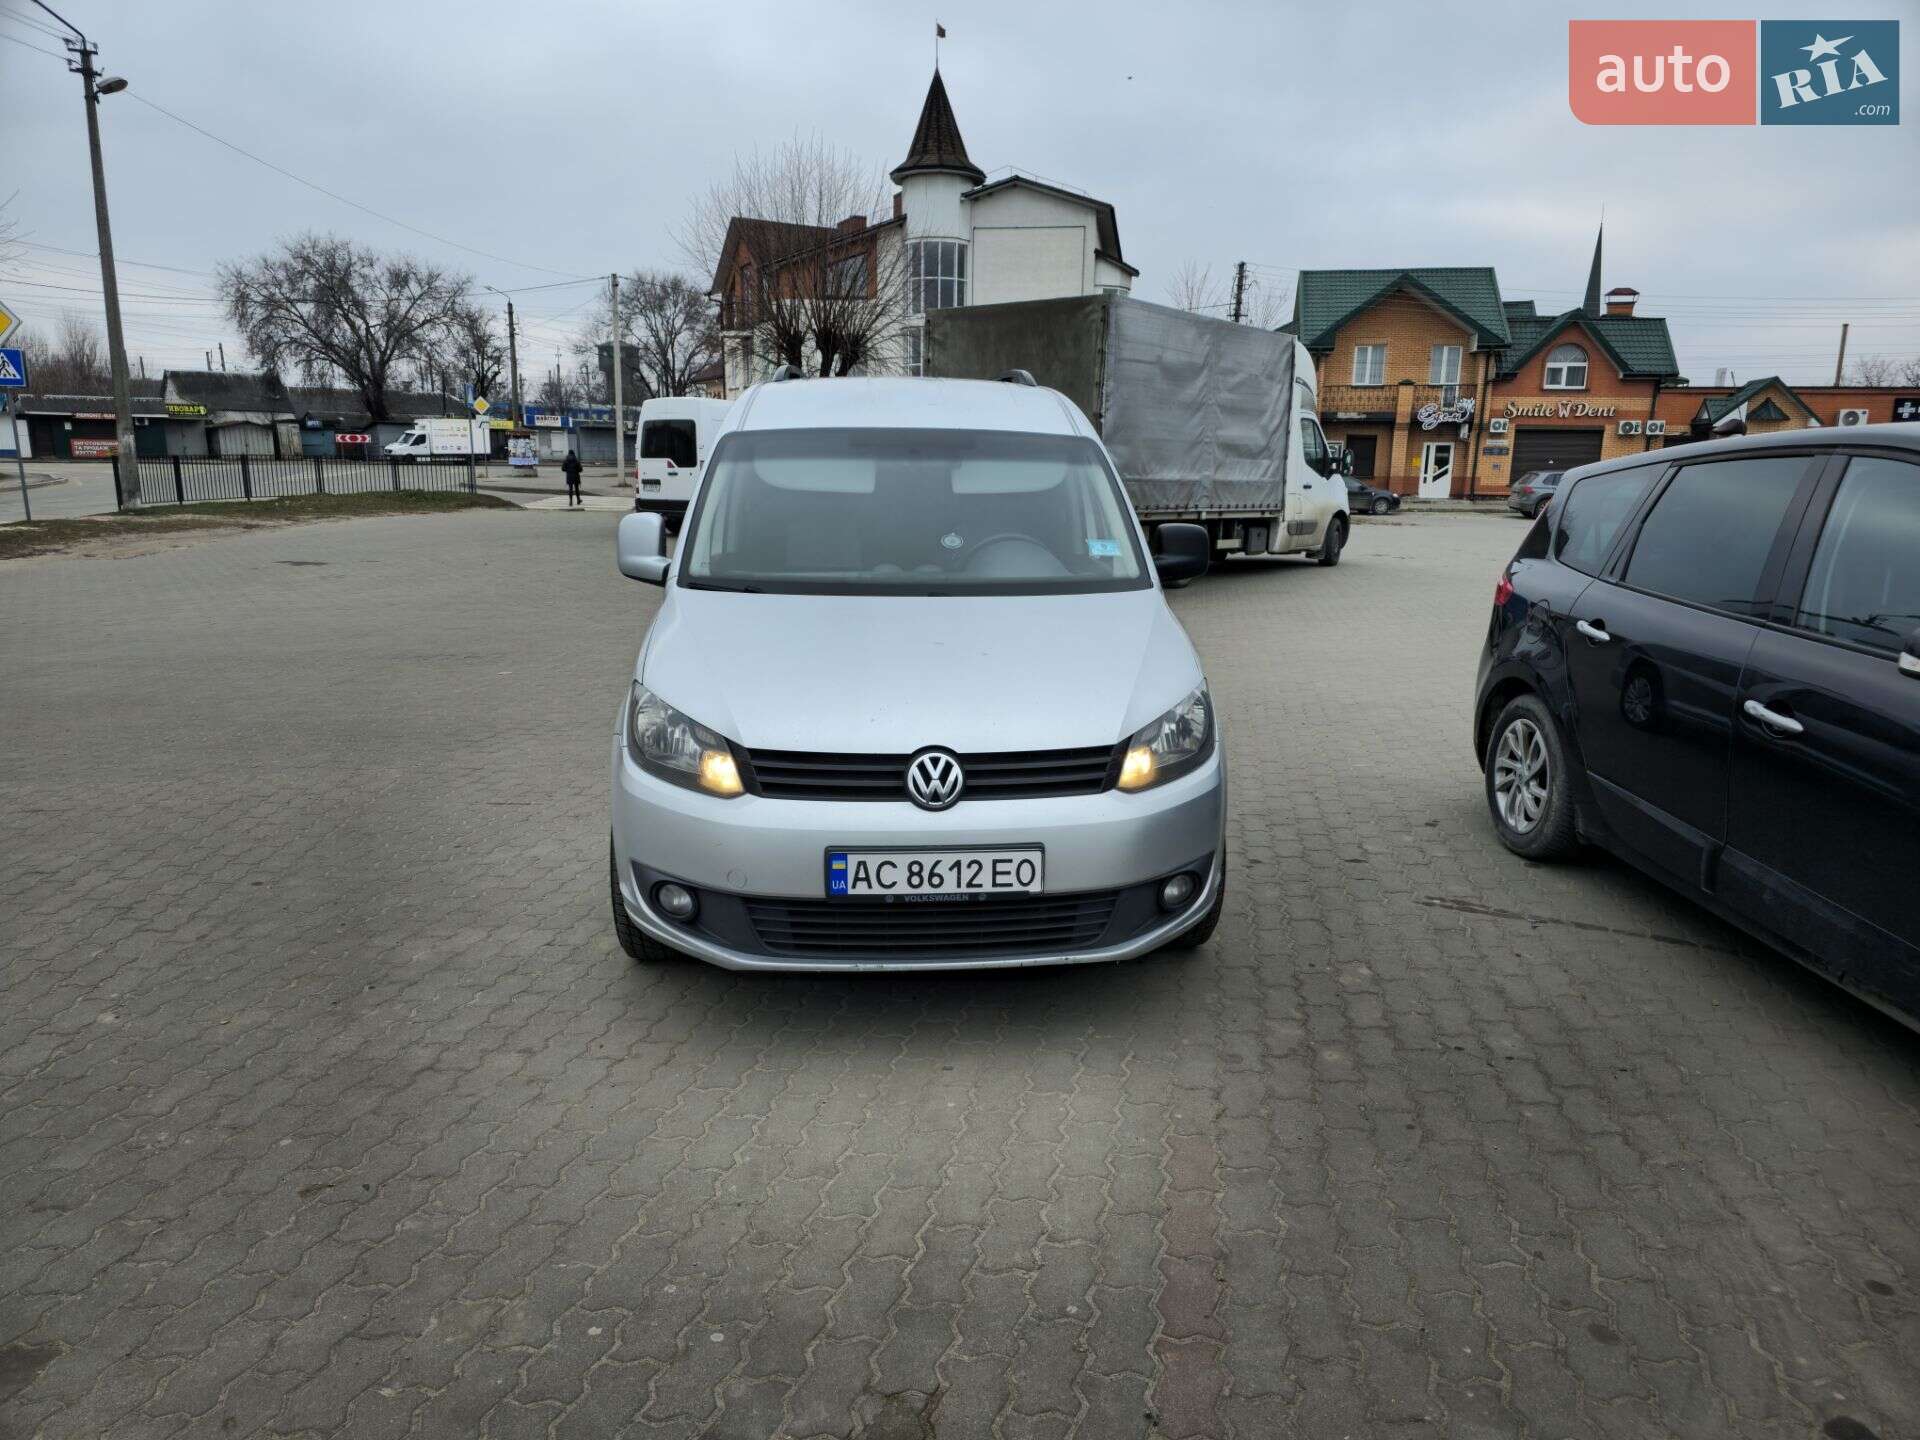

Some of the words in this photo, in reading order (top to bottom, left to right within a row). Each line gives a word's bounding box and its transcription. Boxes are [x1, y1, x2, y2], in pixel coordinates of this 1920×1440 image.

[1503, 401, 1554, 418] Smile
[1573, 400, 1617, 417] Dent
[851, 860, 898, 890] AC
[906, 859, 984, 889] 8612
[991, 858, 1036, 888] EO
[831, 879, 847, 890] UA
[903, 893, 970, 903] VOLKSWAGEN
